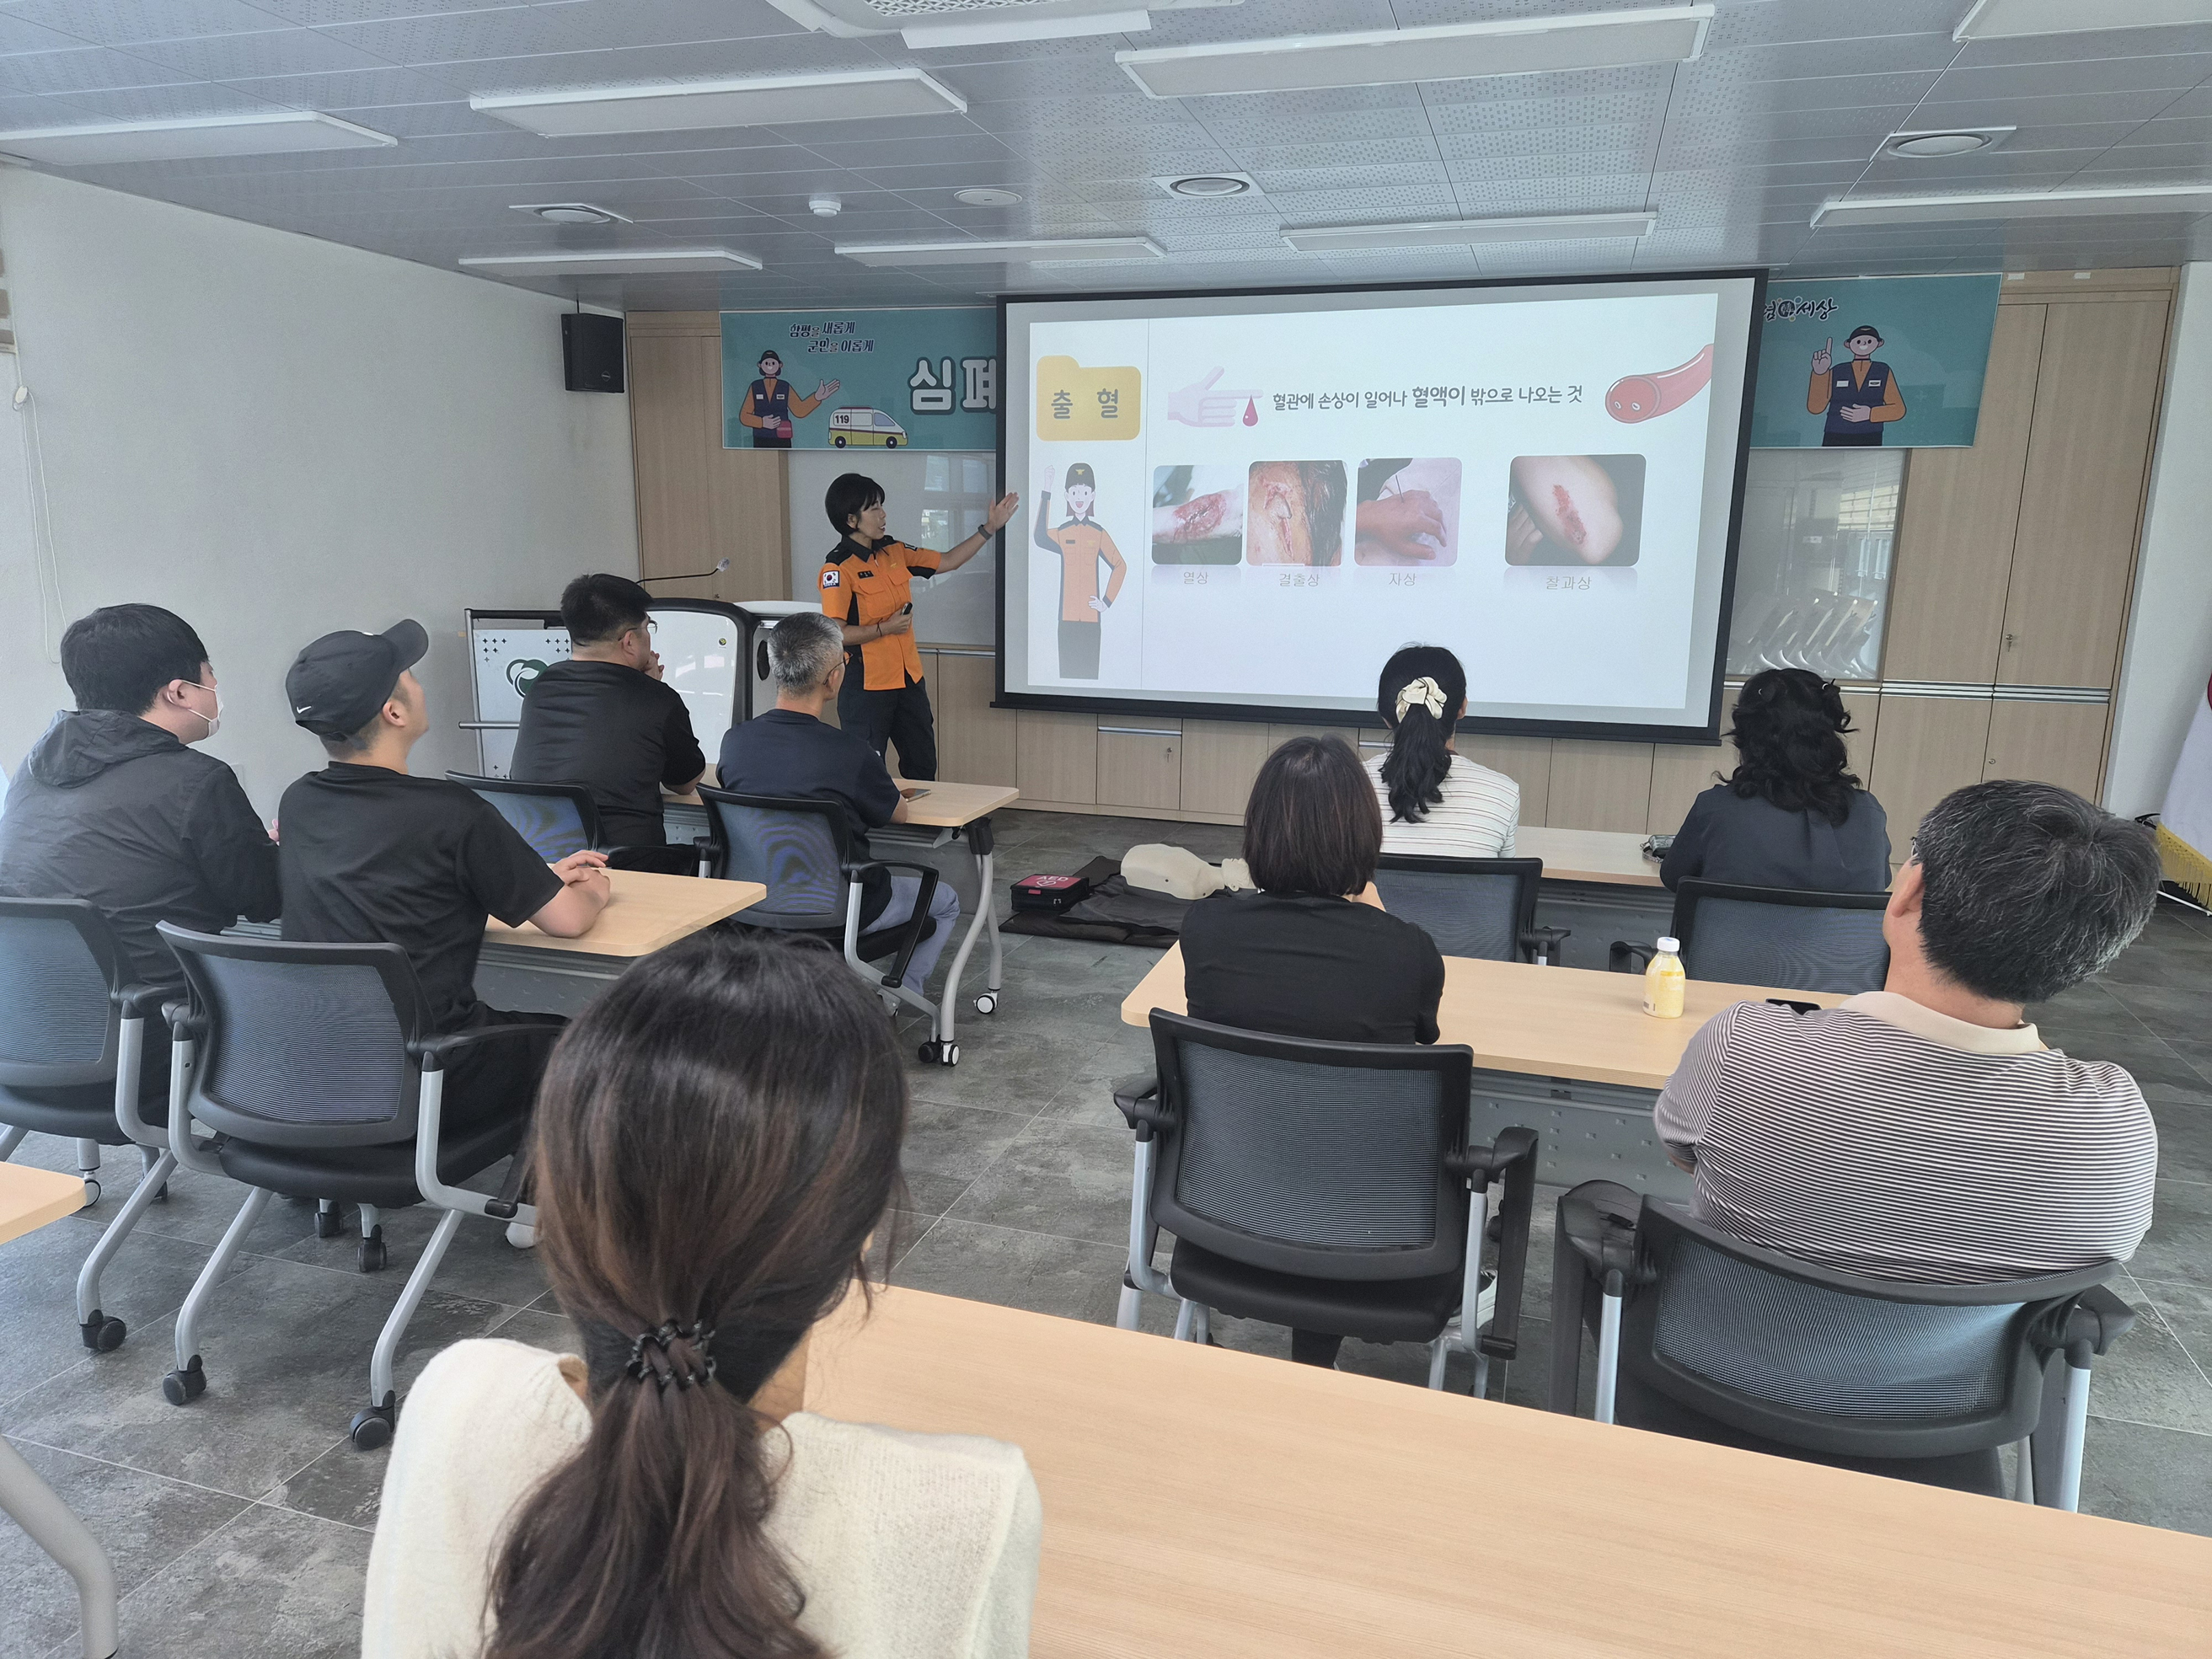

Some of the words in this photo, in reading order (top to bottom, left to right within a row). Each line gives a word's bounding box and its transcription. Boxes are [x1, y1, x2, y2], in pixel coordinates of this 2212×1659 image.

[790, 323, 820, 338] 함평을
[822, 321, 856, 334] 새롭게
[807, 337, 839, 353] 군민을
[841, 339, 875, 352] 이롭게
[1272, 393, 1315, 411] 혈관에
[1317, 391, 1359, 409] 손상이
[1364, 390, 1408, 409] 일어나
[1411, 385, 1465, 409] 혈액이
[1470, 388, 1514, 406] 밖으로
[1518, 385, 1563, 404] 나오는
[1567, 384, 1583, 404] 것
[834, 415, 850, 424] 119
[1183, 571, 1209, 585] 열상
[1278, 573, 1320, 587] 결출상
[1388, 572, 1417, 586] 자상
[1545, 575, 1593, 591] 찰과상
